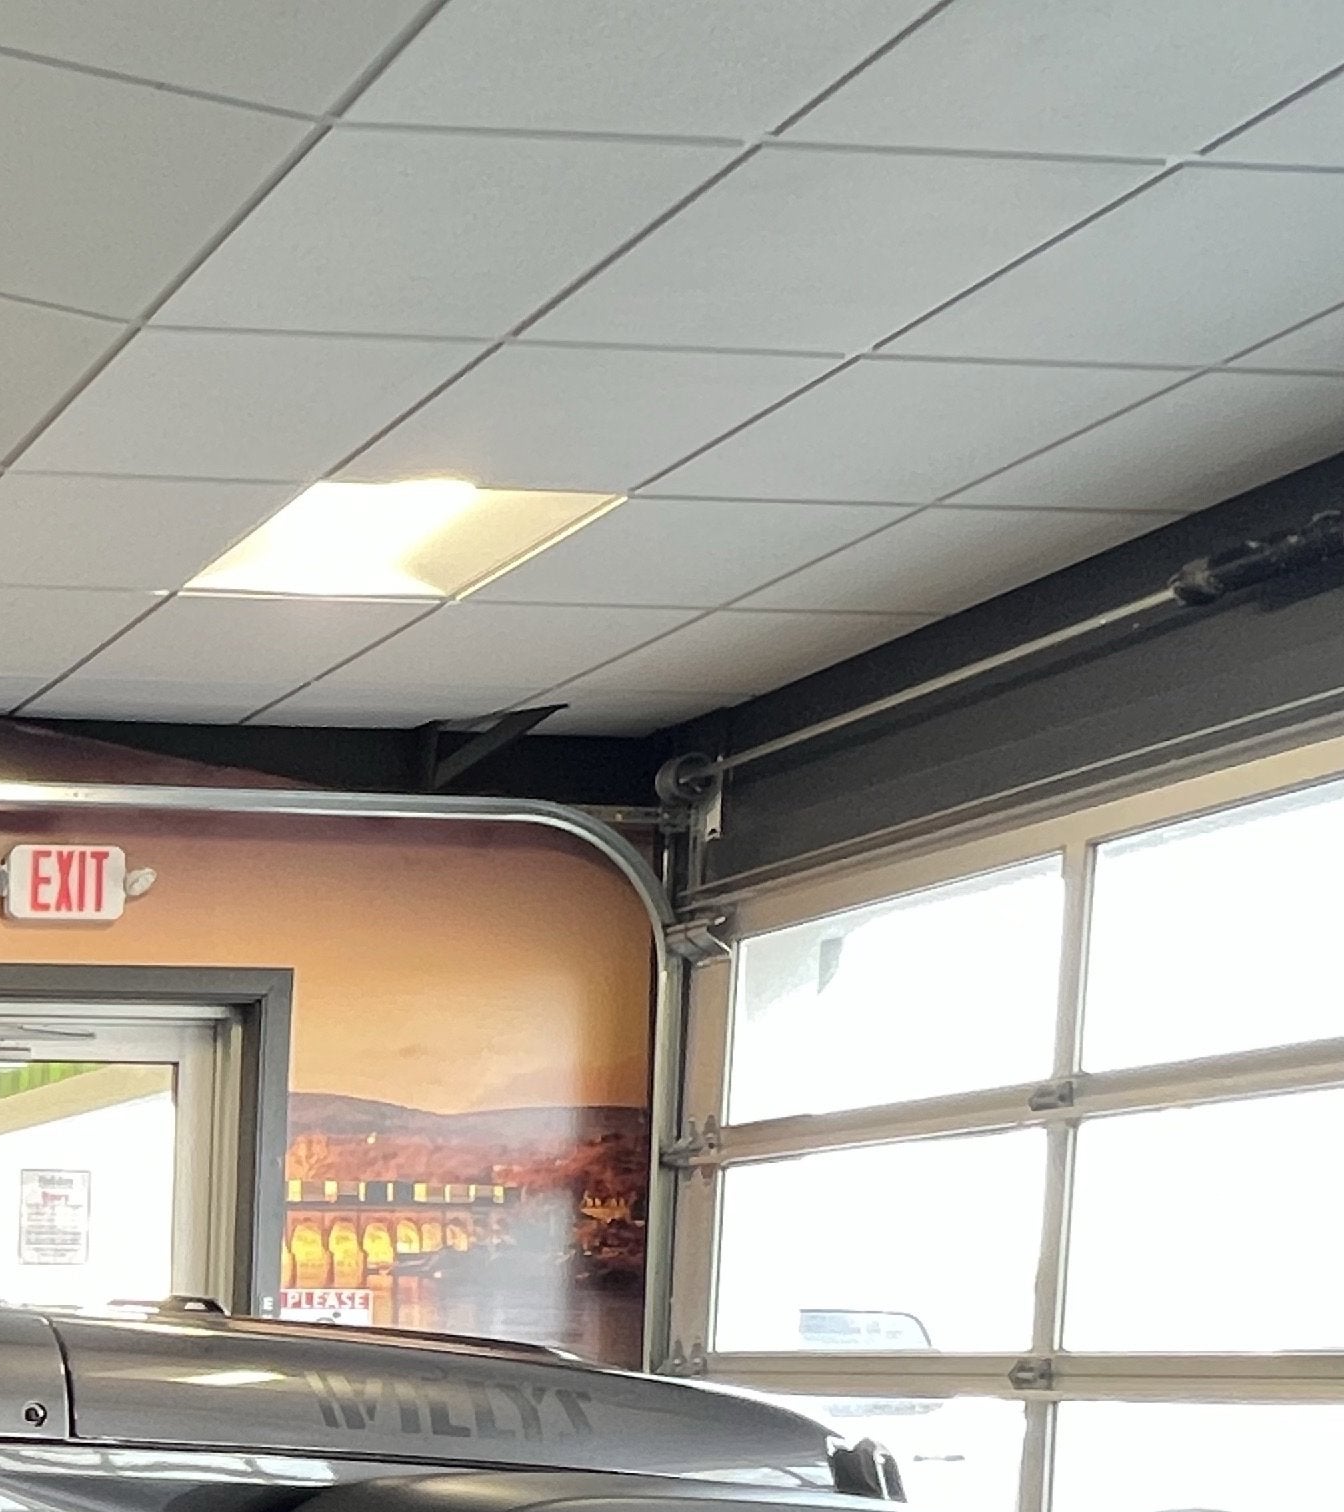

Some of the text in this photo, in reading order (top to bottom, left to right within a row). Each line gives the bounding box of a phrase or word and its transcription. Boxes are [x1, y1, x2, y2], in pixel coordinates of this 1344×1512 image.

[30, 850, 110, 912] EXIT
[286, 1292, 369, 1309] PLEASE
[304, 1371, 593, 1442] WILLYS
